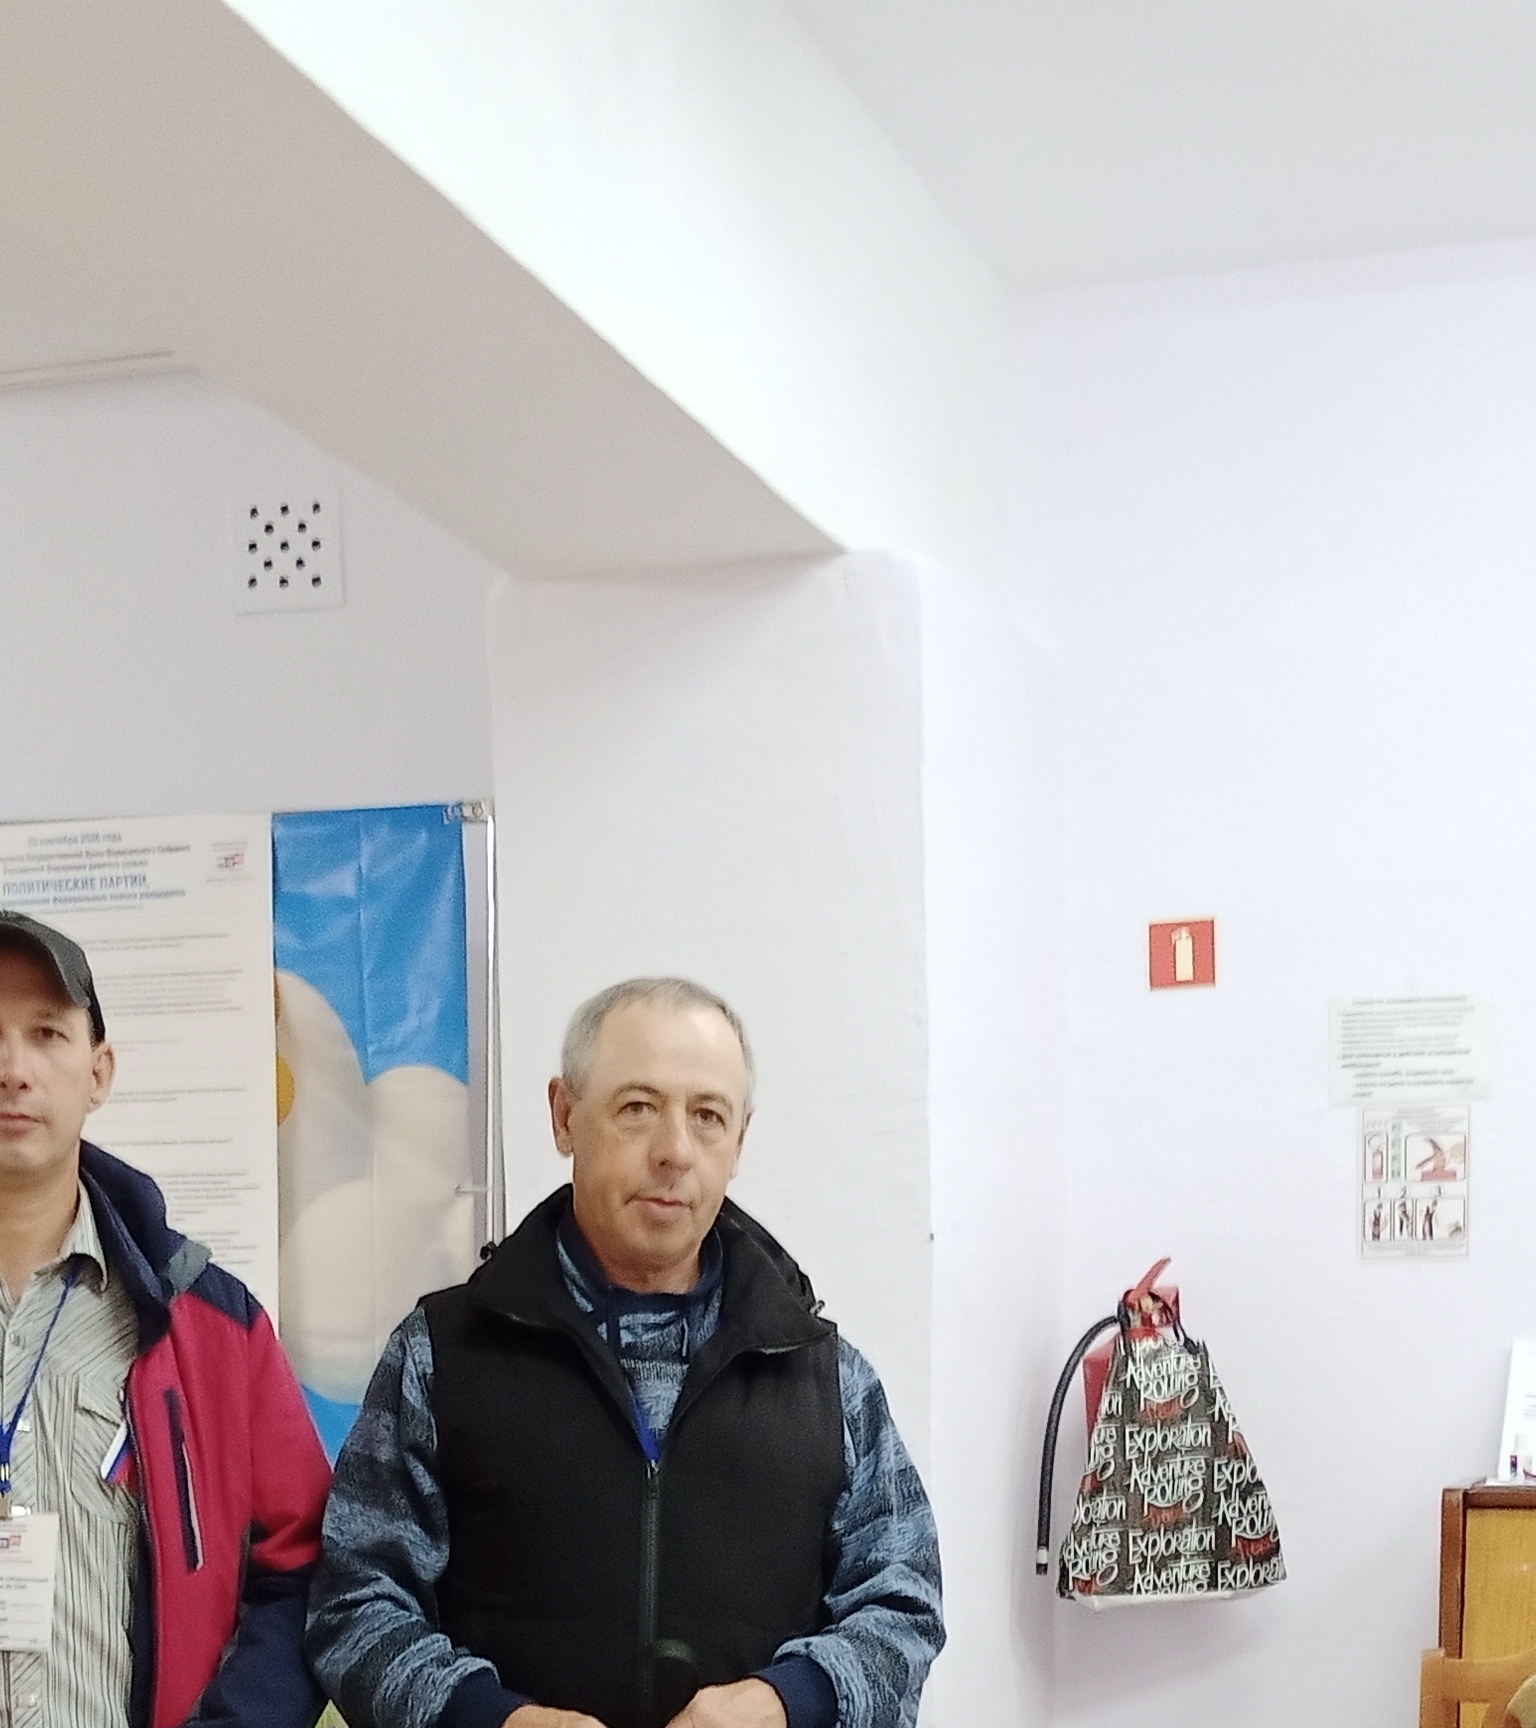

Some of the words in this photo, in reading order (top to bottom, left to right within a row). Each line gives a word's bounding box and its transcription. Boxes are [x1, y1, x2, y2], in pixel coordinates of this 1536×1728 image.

[2, 877, 96, 896] ПОЛИТИЧЕСКИЕ
[1125, 1412, 1212, 1461] Exploration
[1128, 1516, 1216, 1566] Exploration
